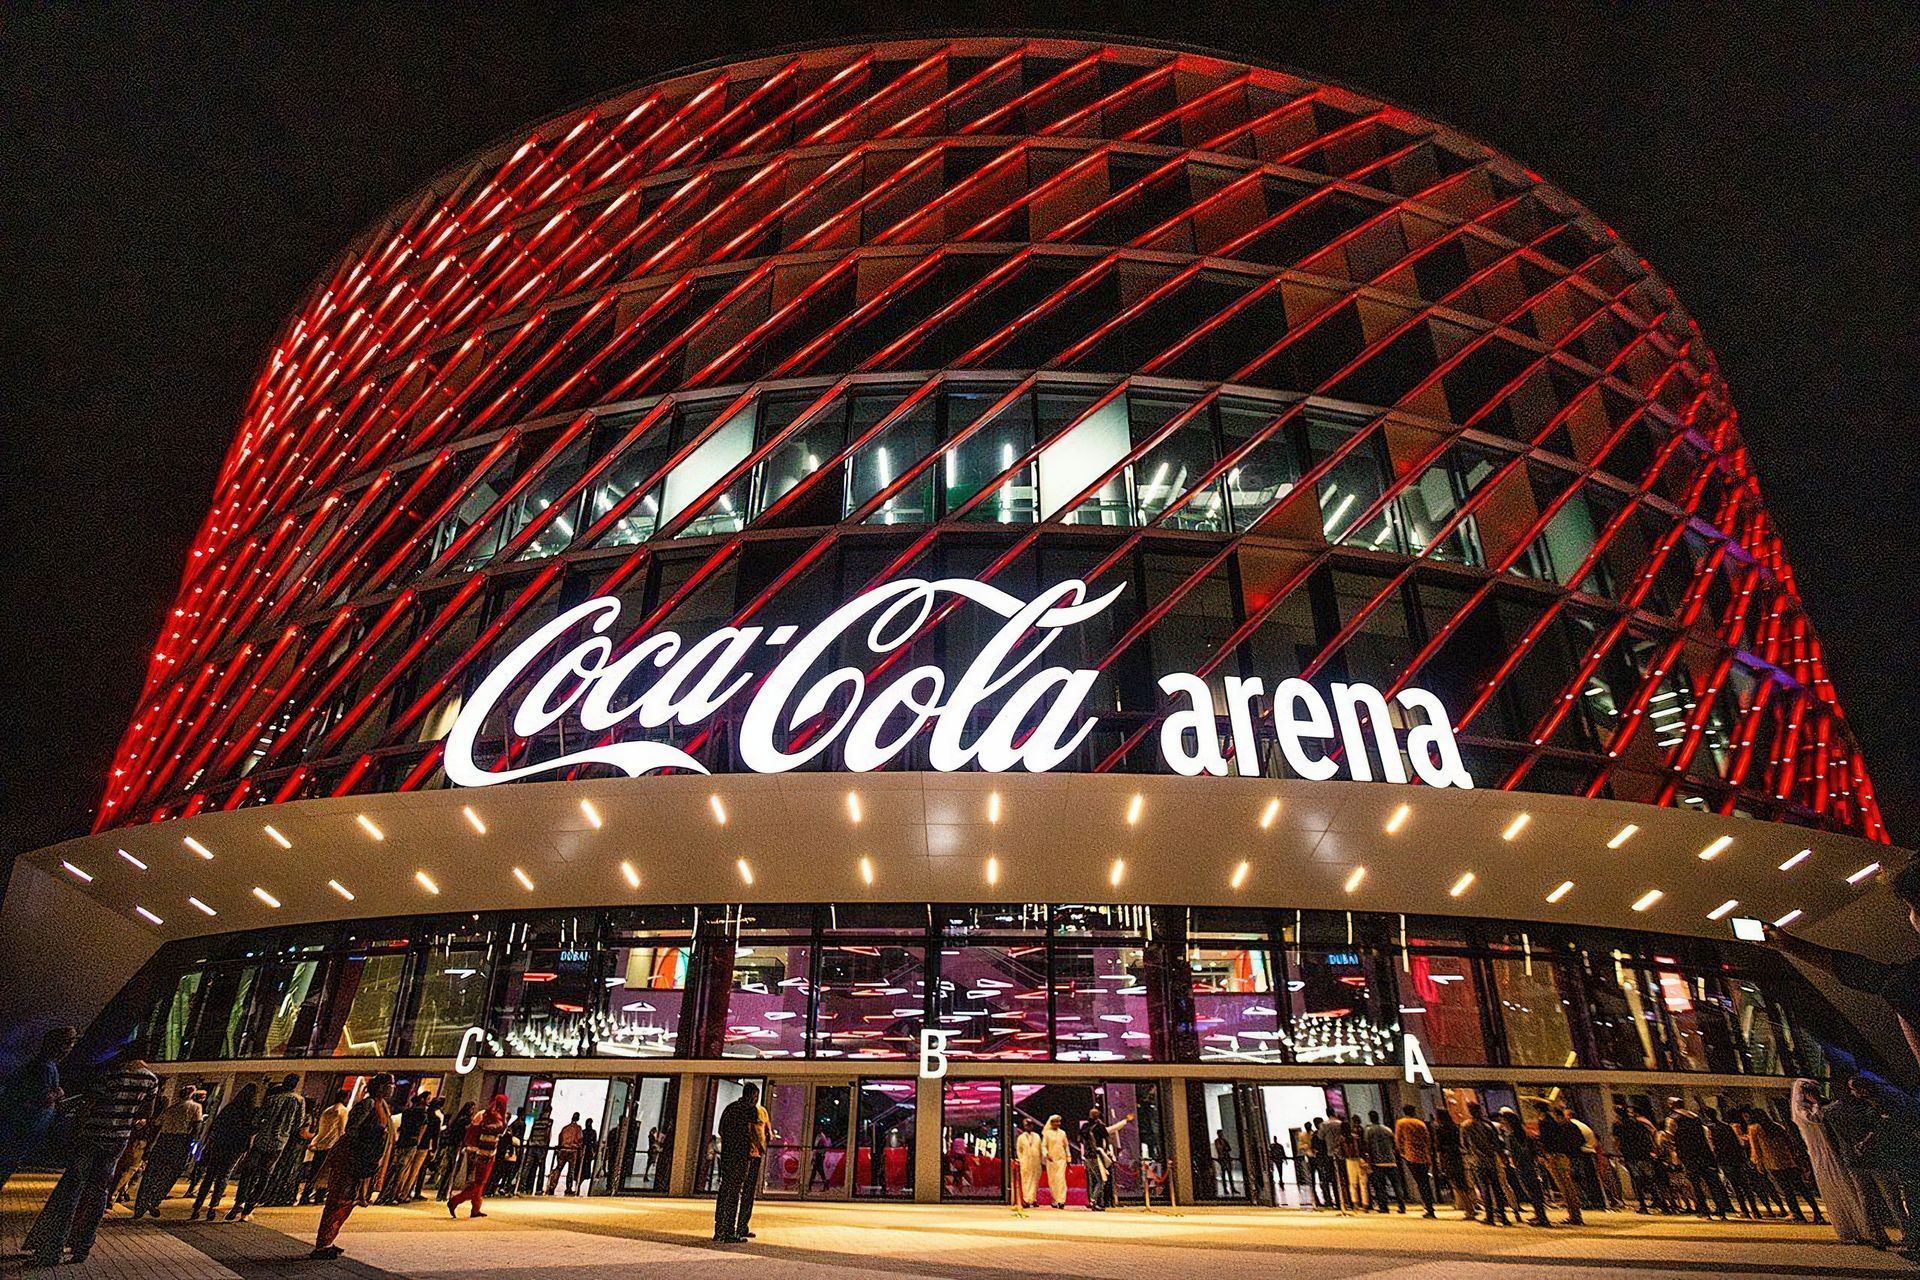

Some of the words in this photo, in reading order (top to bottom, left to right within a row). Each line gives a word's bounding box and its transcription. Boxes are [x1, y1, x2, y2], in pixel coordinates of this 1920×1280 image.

[443, 577, 1128, 787] Coca-Cola
[1157, 672, 1475, 790] arena
[455, 1026, 485, 1075] C
[919, 1028, 948, 1079] B
[1403, 1033, 1435, 1084] A
